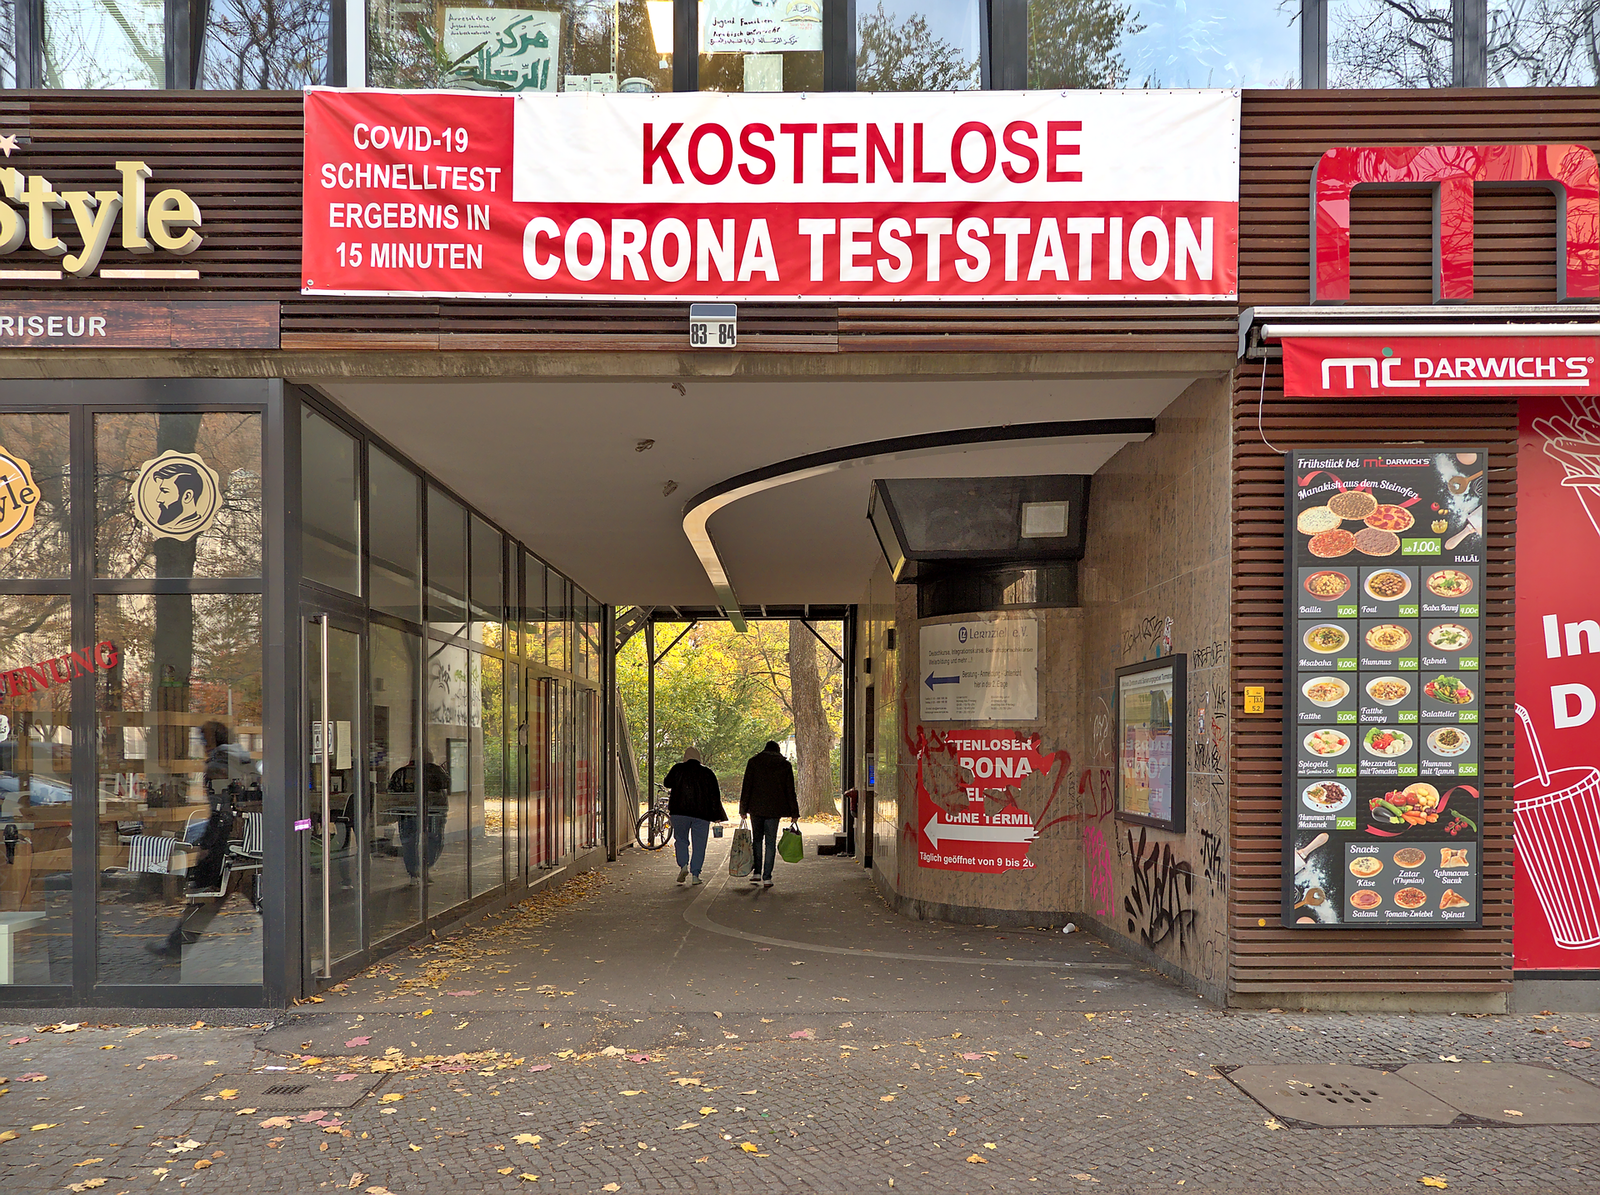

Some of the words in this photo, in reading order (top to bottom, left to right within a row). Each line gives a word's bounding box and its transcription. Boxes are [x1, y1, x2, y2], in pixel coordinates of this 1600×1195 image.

[353, 122, 469, 153] COVID-19
[642, 120, 1083, 185] KOSTENLOSE
[320, 162, 502, 193] SCHNELLTEST
[329, 202, 460, 230] ERGEBNIS
[466, 204, 490, 231] IN
[522, 216, 780, 283] CORONA
[798, 215, 1214, 284] TESTSTATION
[336, 242, 363, 268] 15
[370, 242, 483, 270] MINUTEN
[1297, 458, 1344, 469] Frühstück
[1345, 458, 1360, 469] bei
[1297, 480, 1342, 500] Manakish
[1343, 480, 1359, 488] aus
[1360, 479, 1379, 488] dem
[1380, 480, 1419, 500] Steinofen
[1361, 605, 1378, 613] Foul
[1422, 603, 1440, 612] Baba
[969, 627, 1007, 639] Lernziel
[1361, 658, 1392, 666] Hummus
[1360, 714, 1388, 723] Scampy
[1350, 845, 1379, 853] Snacks
[919, 851, 942, 863] Täglich
[943, 854, 976, 867] geöffnet
[977, 858, 995, 866] von
[997, 857, 1003, 867] 9
[1005, 857, 1020, 868] bis
[1399, 870, 1420, 878] Zatar
[1433, 869, 1470, 878] Lahmacun
[1356, 879, 1376, 887] Käse
[1393, 877, 1425, 885] (Thymian)
[1352, 910, 1378, 918] Salami
[1384, 909, 1434, 918] Tomate-Zwiebel
[1441, 910, 1466, 920] Spinat
